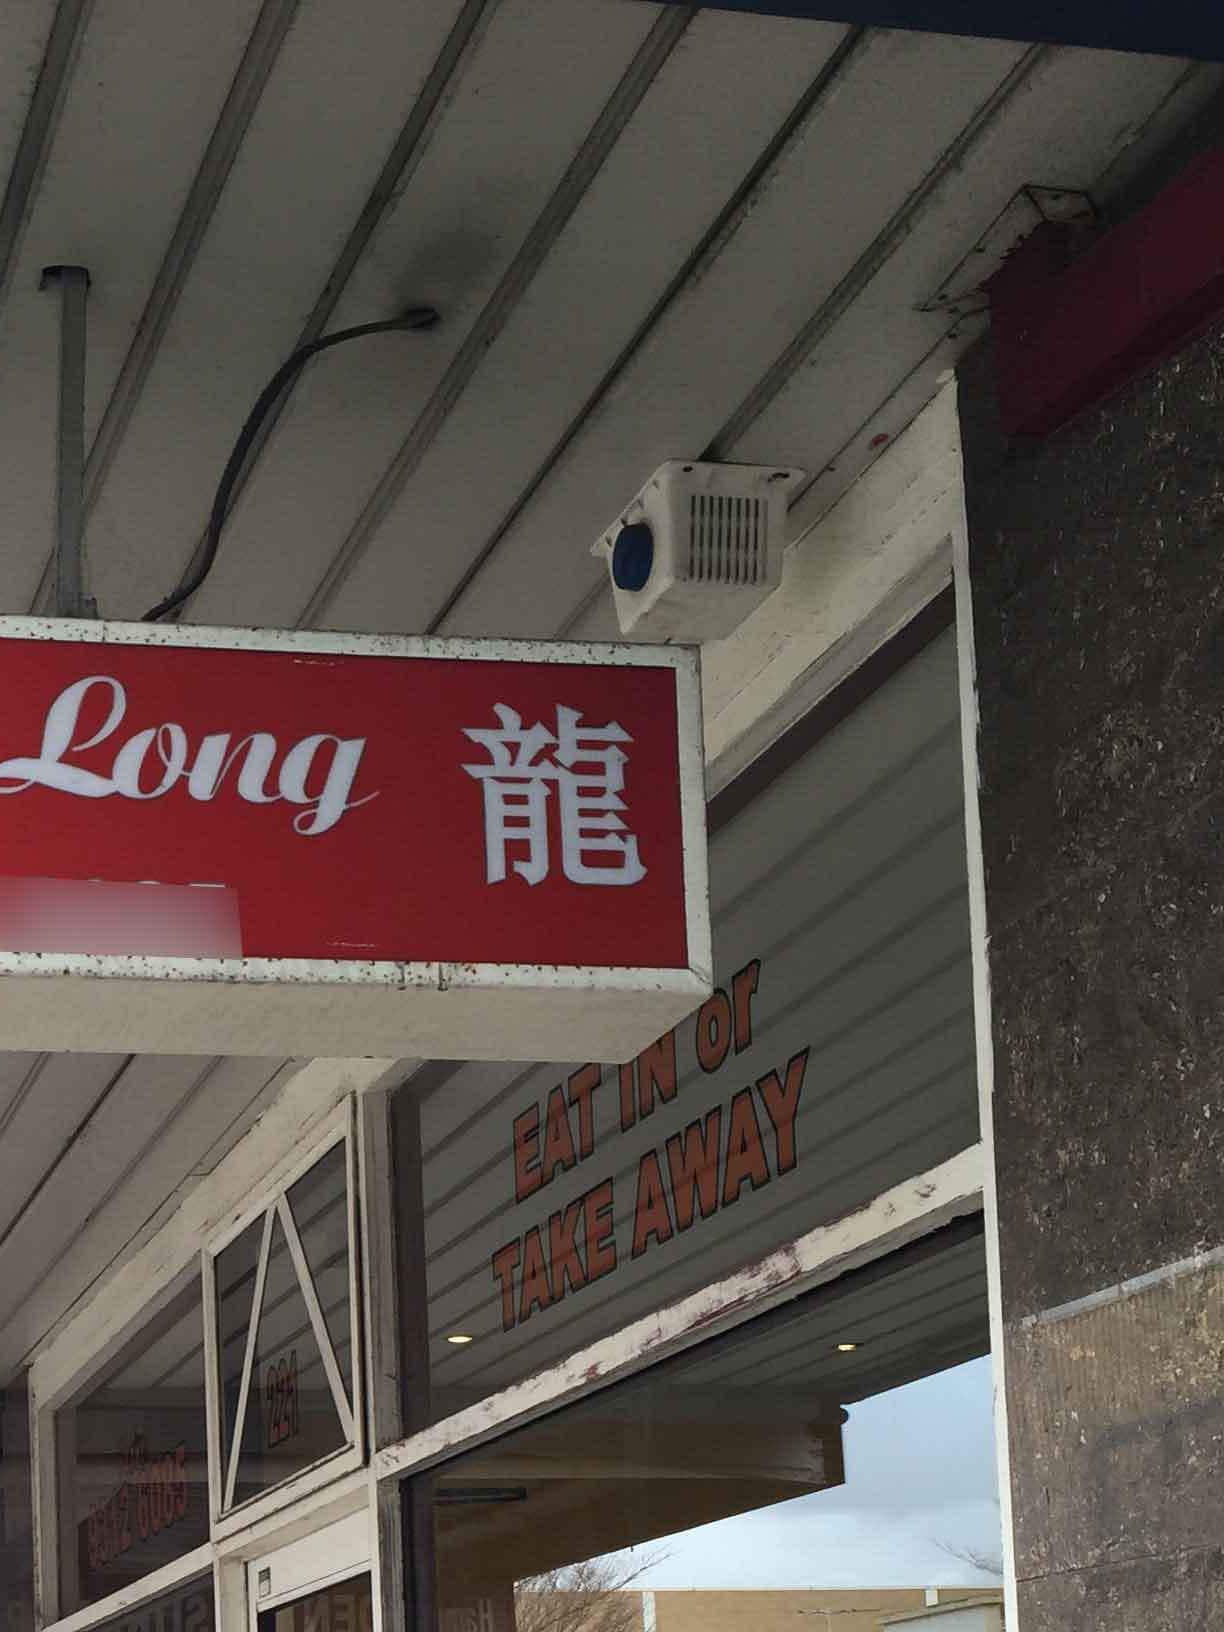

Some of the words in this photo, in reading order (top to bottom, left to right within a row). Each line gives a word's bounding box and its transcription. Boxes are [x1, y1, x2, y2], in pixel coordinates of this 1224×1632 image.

[461, 702, 648, 887] 龍
[492, 1176, 617, 1333] TAKE
[631, 1045, 811, 1260] AWAY
[513, 1062, 602, 1203] EAT
